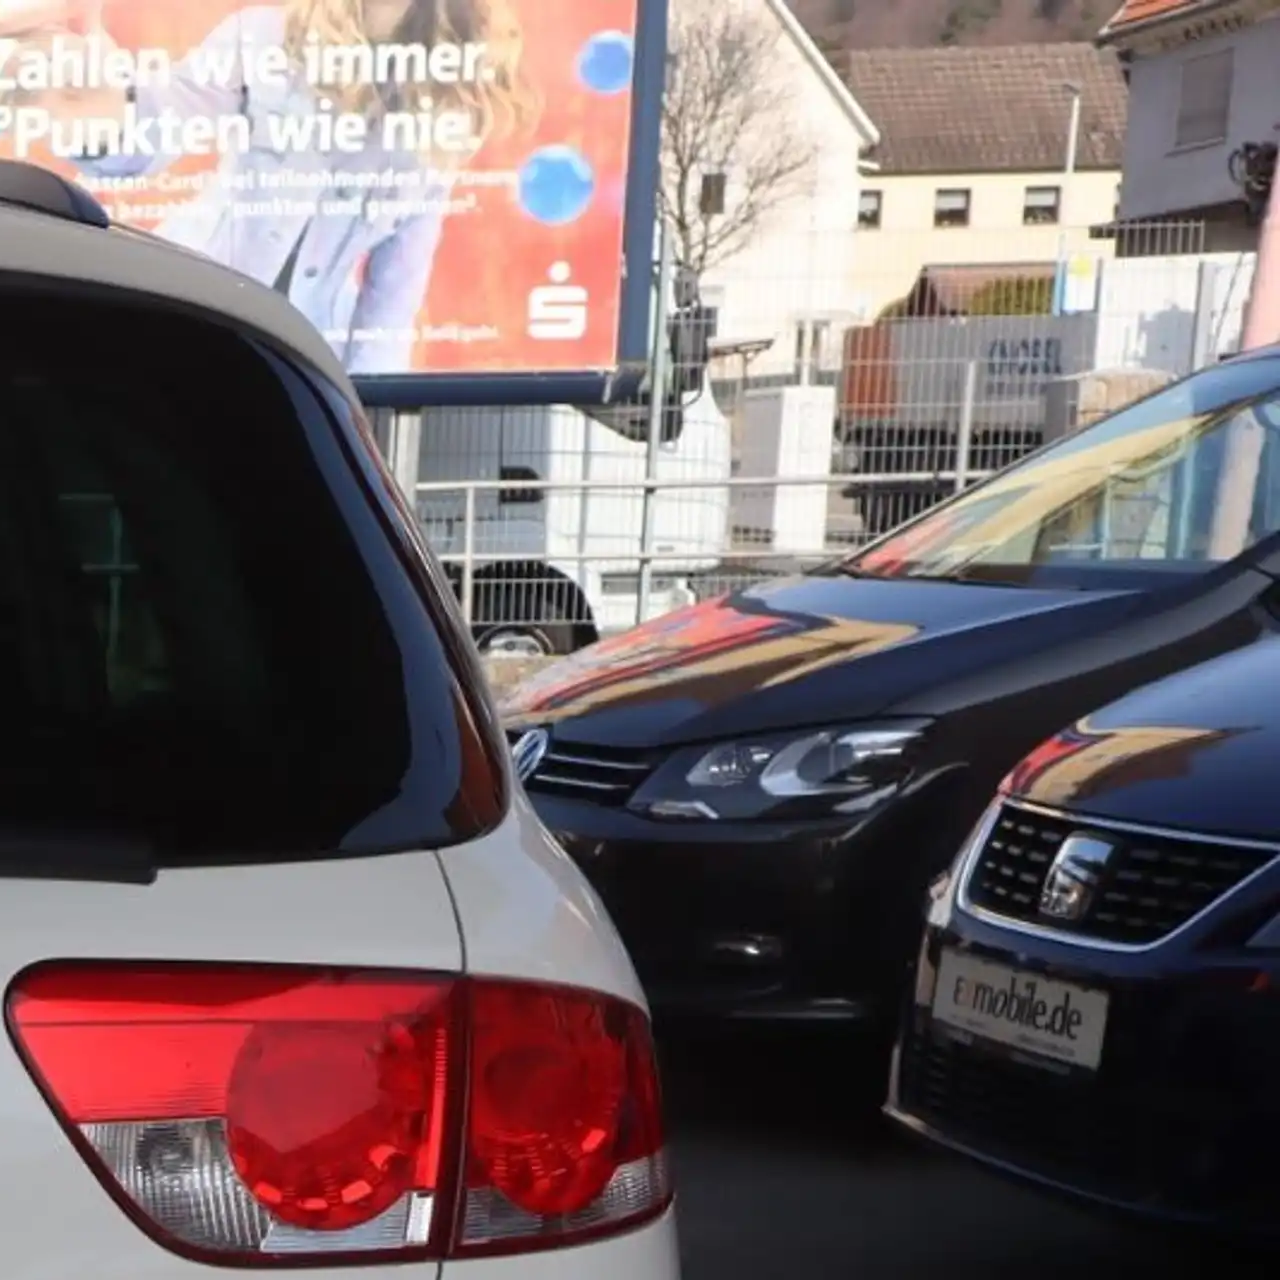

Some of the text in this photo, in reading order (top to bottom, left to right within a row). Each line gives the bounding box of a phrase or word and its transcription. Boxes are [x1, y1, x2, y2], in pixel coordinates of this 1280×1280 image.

[189, 33, 289, 84] wie
[306, 31, 495, 82] immer.
[268, 98, 367, 152] wie
[382, 97, 484, 152] nie.
